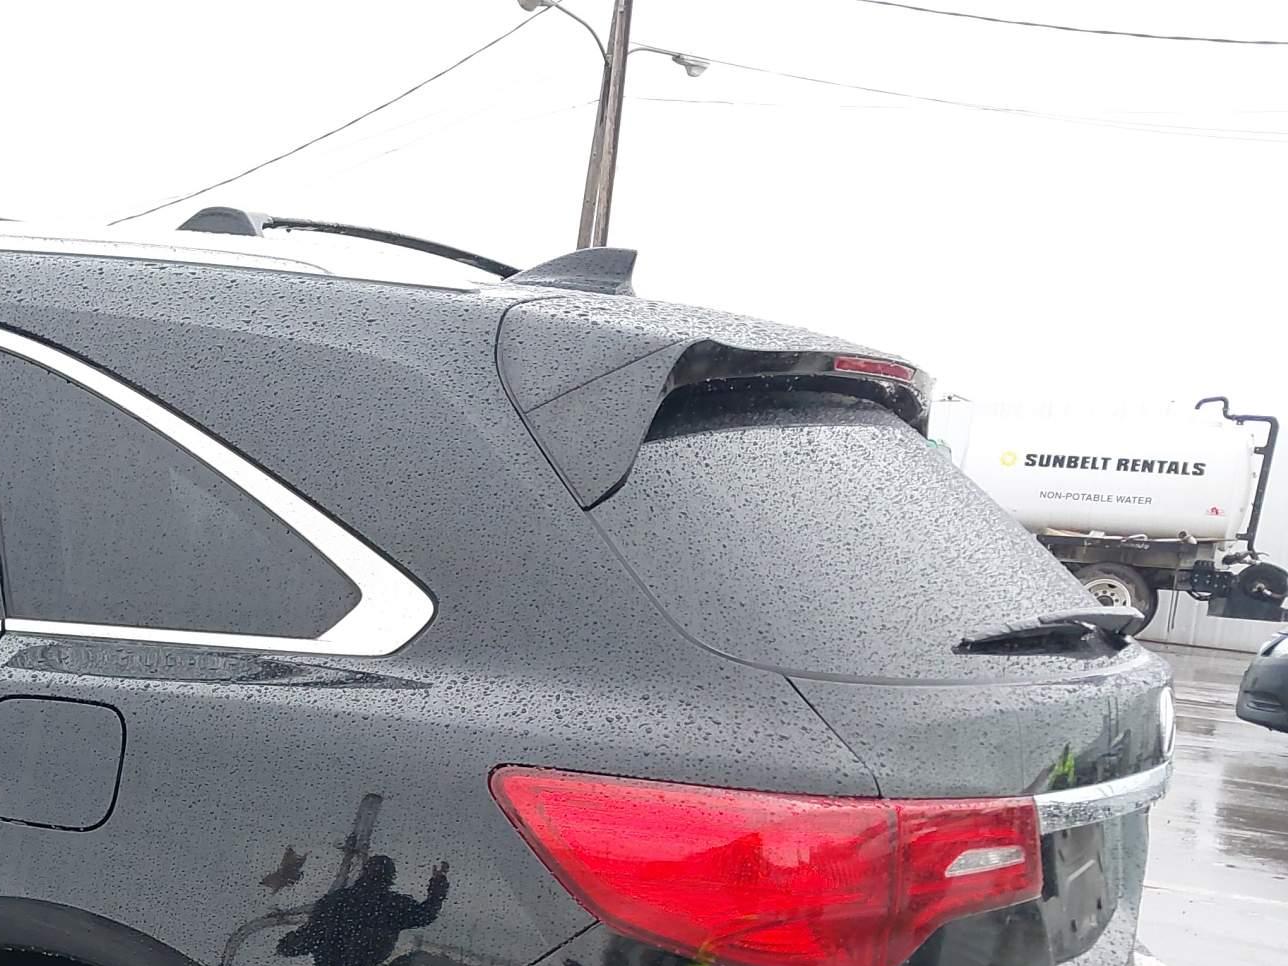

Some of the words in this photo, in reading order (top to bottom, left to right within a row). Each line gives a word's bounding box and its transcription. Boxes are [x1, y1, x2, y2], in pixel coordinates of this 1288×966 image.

[1024, 453, 1112, 471] SUNBELT
[1116, 457, 1207, 476] RENTALS
[1039, 490, 1113, 503] NON-POTABLE
[1115, 495, 1153, 505] WATER
